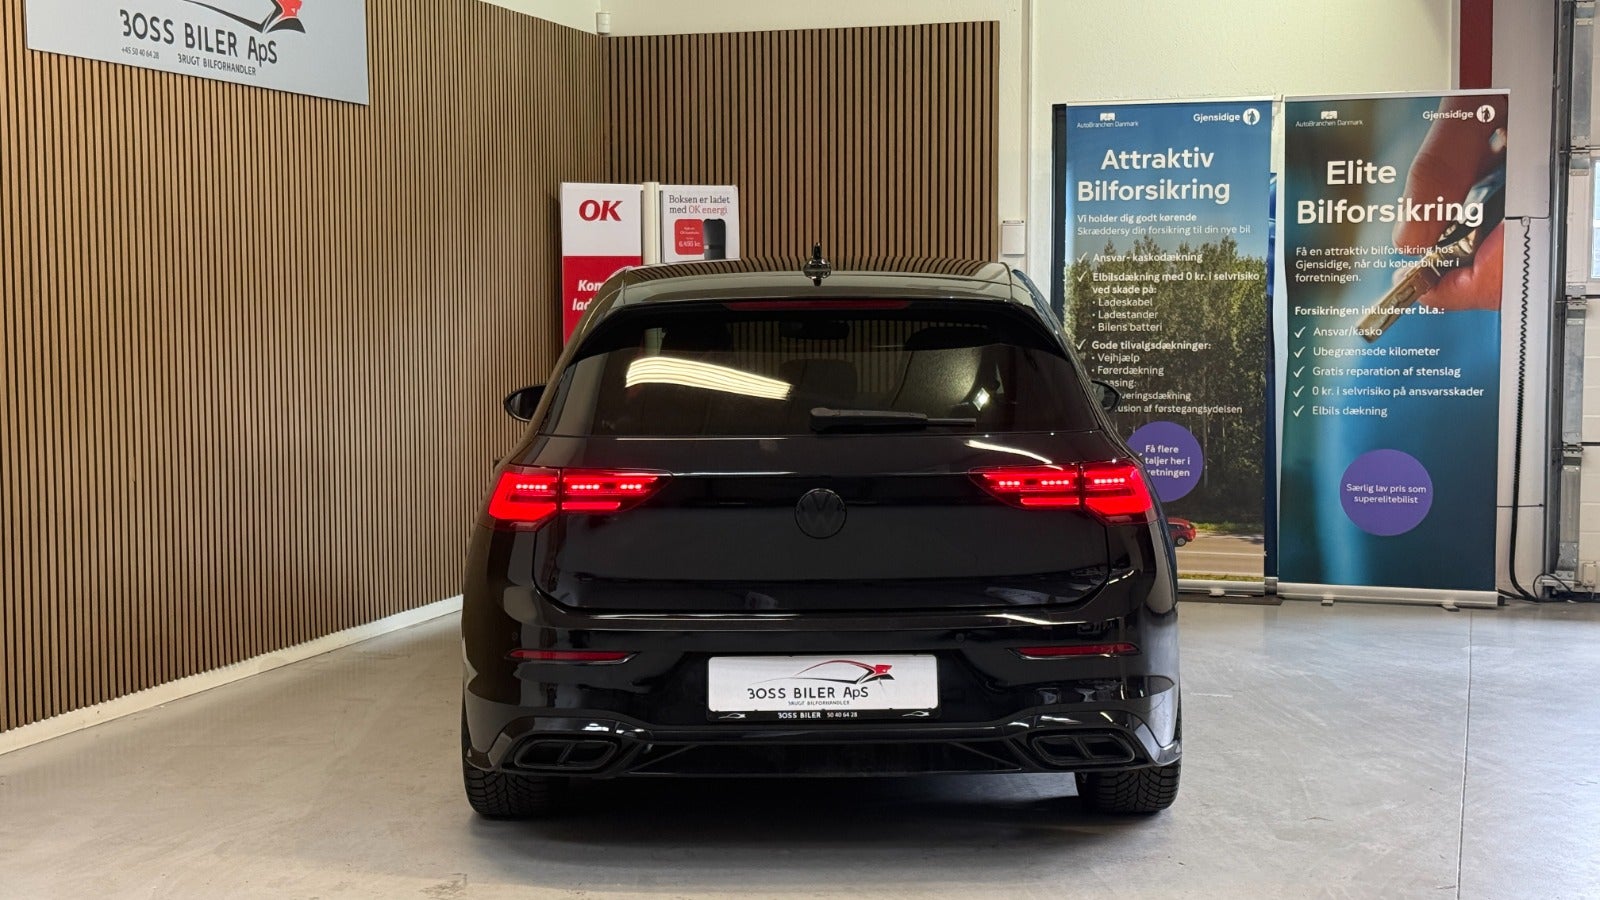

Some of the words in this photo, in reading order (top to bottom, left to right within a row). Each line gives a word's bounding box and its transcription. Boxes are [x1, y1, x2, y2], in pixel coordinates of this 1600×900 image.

[184, 22, 238, 58] BILER
[248, 35, 278, 67] ApS
[203, 58, 256, 76] BILFORHANDLER
[1193, 112, 1240, 122] Gjensidige
[1422, 110, 1474, 120] Gjensidige
[1101, 147, 1214, 170] Attraktiv
[1326, 158, 1397, 186] Elite
[1078, 178, 1230, 204] Bilforsikring
[669, 195, 698, 204] Boksen
[710, 196, 730, 204] ladet
[579, 200, 624, 221] OK
[670, 206, 687, 214] med
[688, 205, 700, 214] OK
[702, 206, 728, 216] energi
[1297, 196, 1484, 228] Bilforsikring
[1078, 214, 1086, 222] Vi
[1088, 214, 1118, 222] holder
[1120, 214, 1134, 224] dig
[1136, 214, 1157, 224] godt
[1159, 213, 1196, 222] kørende
[1078, 227, 1130, 236] Skræddersy
[1132, 226, 1146, 235] din
[1149, 226, 1190, 236] forsikring
[1193, 226, 1202, 234] til
[1204, 226, 1218, 234] din
[1221, 228, 1238, 236] nye
[1240, 225, 1250, 234] bil
[1296, 246, 1308, 256] Få
[1324, 246, 1368, 256] attraktiv
[1371, 245, 1433, 256] bilforsikring
[1436, 245, 1454, 254] hos
[1093, 254, 1130, 262] Ansvar-
[1132, 253, 1202, 264] kaskodækning
[1296, 260, 1352, 270] Gjensidige,
[1354, 258, 1370, 268] når
[1373, 258, 1386, 268] du
[1389, 258, 1419, 268] køber
[1421, 258, 1434, 268] bil
[1436, 258, 1454, 267] her
[1456, 258, 1460, 267] i
[1093, 273, 1160, 283] Elbilsdækning
[1162, 272, 1184, 281] med
[1186, 272, 1192, 280] 0
[1194, 272, 1208, 280] kr.
[1214, 272, 1260, 281] selvrisiko
[1296, 273, 1362, 284] forretningen.
[1092, 286, 1110, 294] ved
[1112, 285, 1140, 294] skade
[1142, 284, 1157, 296] på:
[1098, 298, 1153, 306] Ladeskabel
[1098, 310, 1158, 319] Ladestander
[1294, 306, 1359, 317] Forsikringen
[1362, 306, 1416, 315] inkluderer
[1418, 306, 1444, 314] bl.a.:
[1098, 323, 1128, 332] Bilens
[1130, 322, 1162, 332] batteri
[1313, 327, 1383, 337] Ansvar/kasko
[1092, 341, 1118, 350] Gode
[1120, 340, 1212, 351] tilvalgsdækninger:
[1313, 347, 1386, 358] Ubegrænsede
[1389, 346, 1440, 356] kilometer
[1098, 354, 1140, 364] Vejhjælp
[1098, 366, 1164, 376] Førerdækning
[1312, 366, 1344, 376] Gratis
[1346, 366, 1400, 378] reparation
[1402, 366, 1414, 376] af
[1416, 366, 1461, 378] stenslag
[1105, 378, 1136, 389] asing:
[1121, 390, 1191, 401] veringsdækning
[1312, 386, 1318, 396] 0
[1321, 386, 1334, 396] kr.
[1342, 386, 1390, 396] selvrisiko
[1393, 386, 1406, 398] på
[1408, 386, 1484, 396] ansvarsskader
[1144, 404, 1152, 412] af
[1154, 404, 1242, 414] førstegangsydelsen
[1312, 406, 1340, 416] Elbils
[1342, 406, 1388, 418] dækning
[1146, 444, 1156, 452] Få
[1158, 444, 1179, 453] flere
[1145, 456, 1168, 466] taljer
[1170, 456, 1186, 464] her
[1187, 456, 1190, 464] i
[1346, 484, 1374, 494] Særlig
[1376, 484, 1388, 493] lav
[1390, 484, 1406, 494] pris
[1354, 495, 1418, 506] superelitebilist
[794, 688, 835, 698] BILER
[843, 686, 868, 700] ApS
